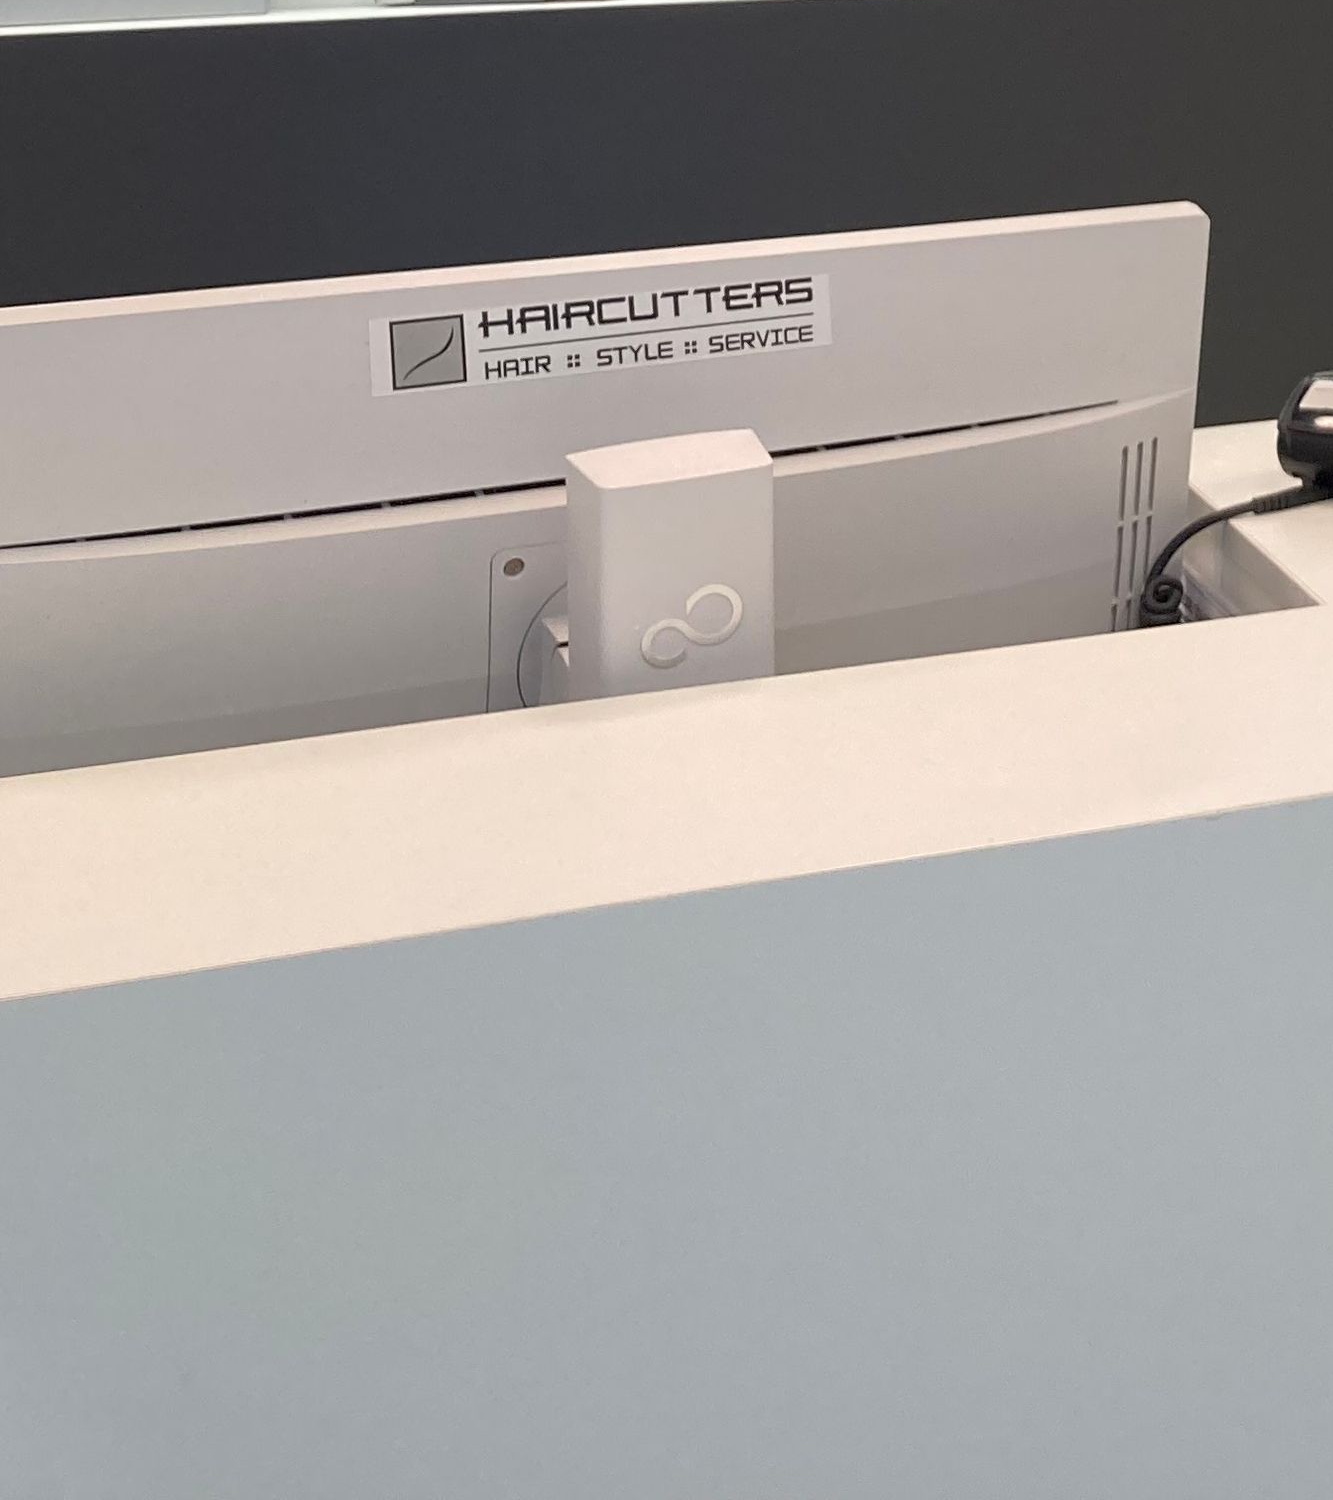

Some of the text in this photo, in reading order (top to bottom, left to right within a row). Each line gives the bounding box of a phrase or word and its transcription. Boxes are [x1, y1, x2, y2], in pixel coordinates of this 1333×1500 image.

[478, 276, 814, 339] HAIRCUTTERS
[484, 324, 815, 381] HAIR STYLE SERVICE
